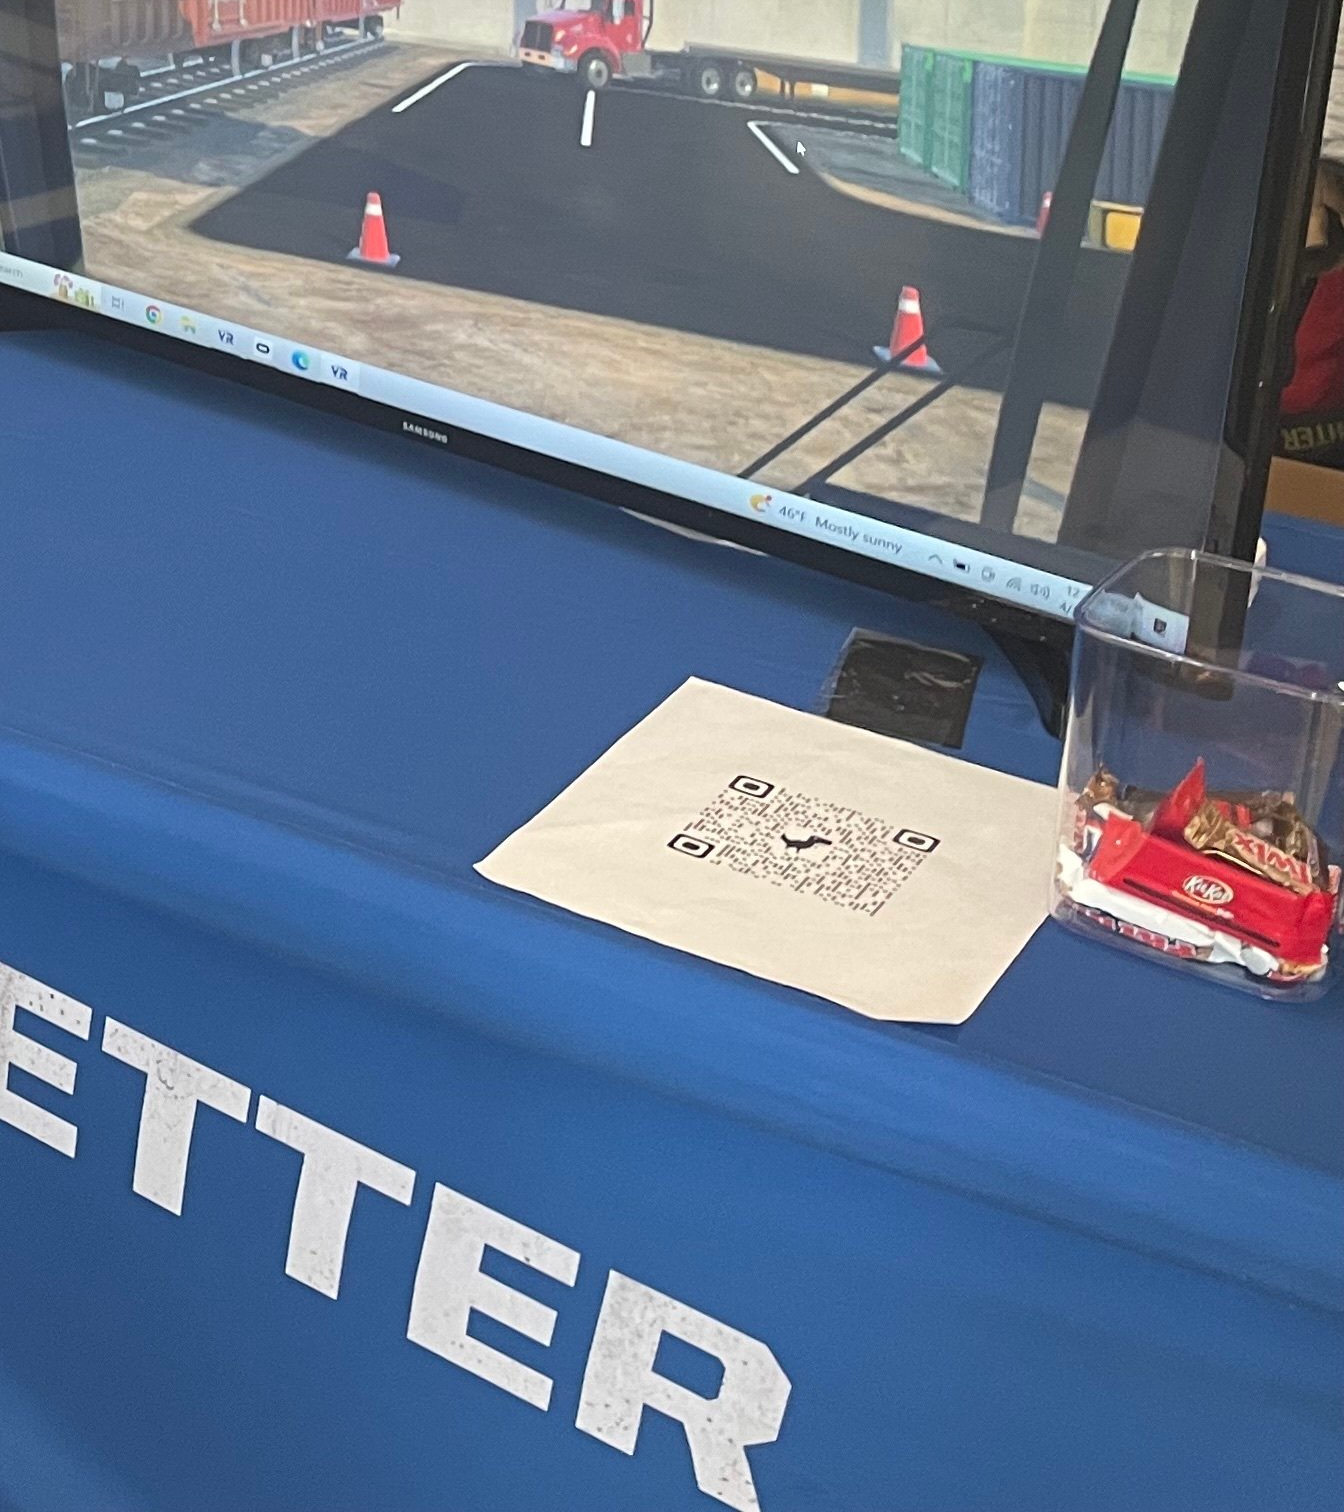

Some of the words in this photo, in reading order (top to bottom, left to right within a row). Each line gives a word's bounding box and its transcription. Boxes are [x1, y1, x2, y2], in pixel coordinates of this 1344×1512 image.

[218, 329, 234, 346] VR
[330, 364, 348, 382] VR
[403, 421, 448, 444] SAMSUNG
[815, 517, 860, 542] Mostly
[863, 535, 903, 555] sunny
[1233, 829, 1310, 886] TWIX
